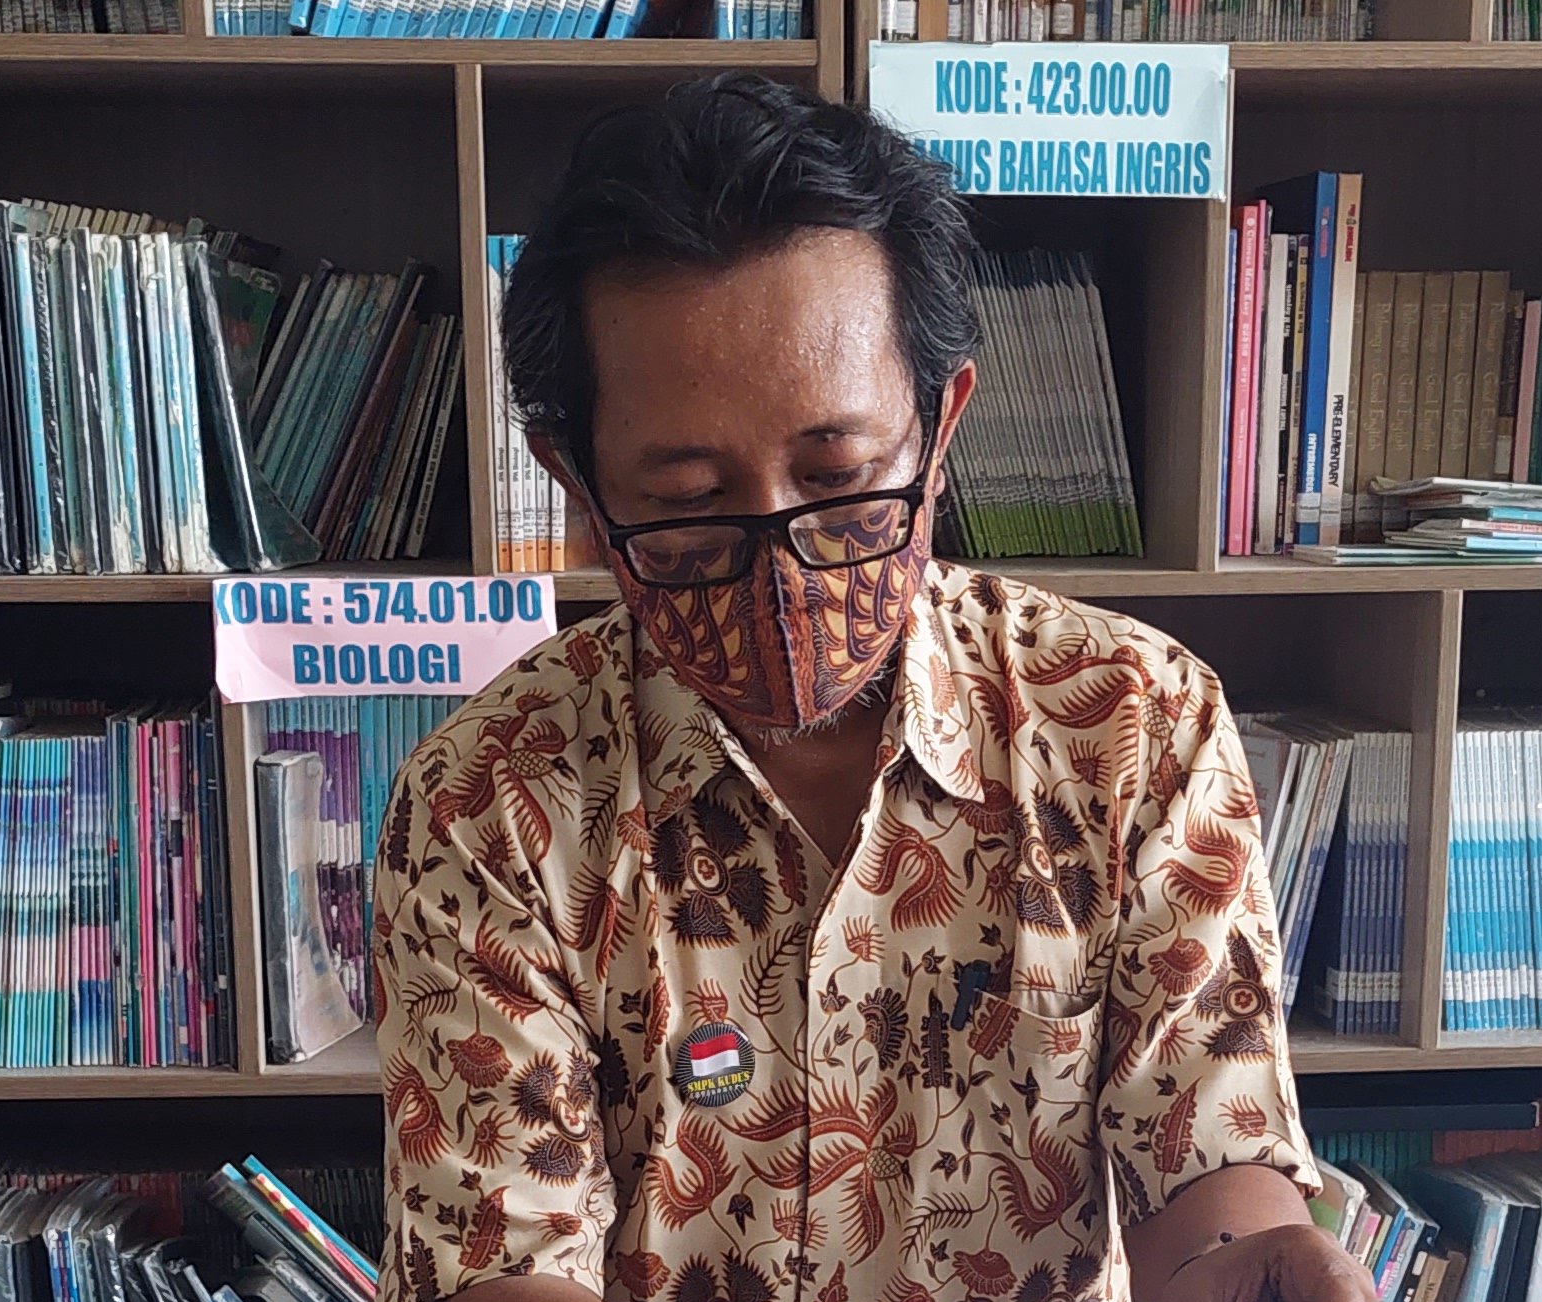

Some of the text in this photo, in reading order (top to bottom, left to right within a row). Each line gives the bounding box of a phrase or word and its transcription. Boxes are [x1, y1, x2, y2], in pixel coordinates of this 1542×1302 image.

[936, 61, 1006, 116] KODE
[1028, 62, 1171, 117] 423.00.00
[1000, 142, 1107, 195] BAHASA
[1115, 142, 1212, 195] INGRIS
[1305, 433, 1317, 494] INTERMEDIA
[345, 580, 542, 623] 574.01.00
[294, 644, 460, 684] BIOLOGI
